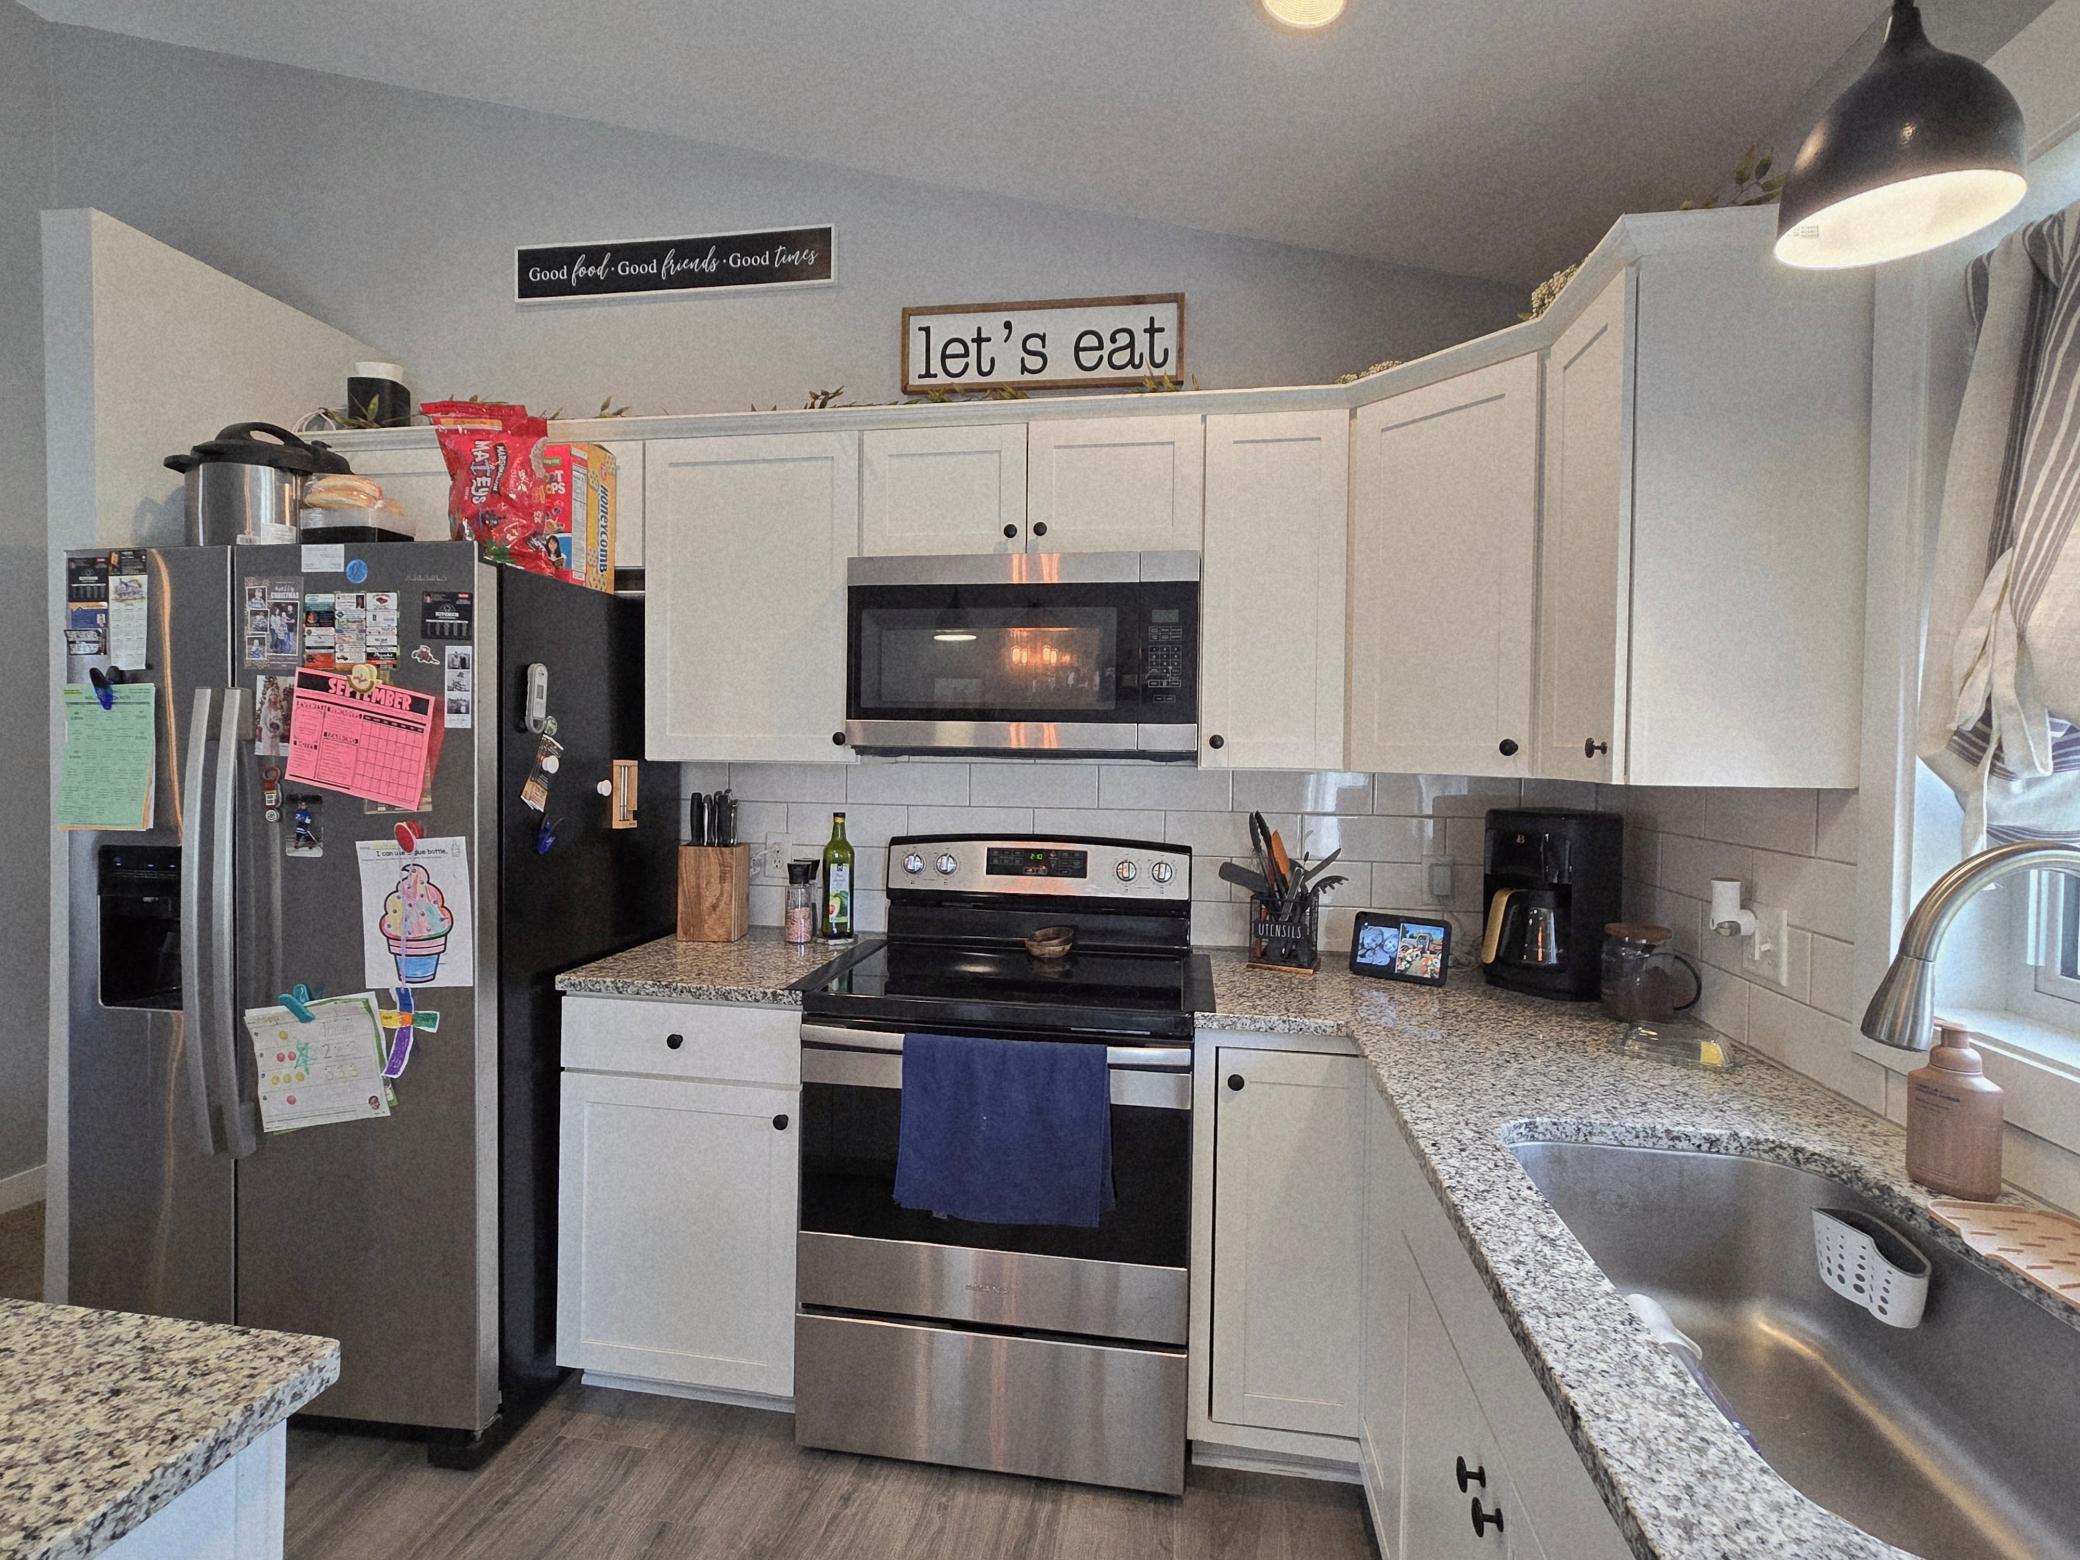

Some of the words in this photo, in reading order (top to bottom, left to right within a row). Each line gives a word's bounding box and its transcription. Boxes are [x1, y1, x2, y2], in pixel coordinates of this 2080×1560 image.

[528, 265, 567, 282] Good
[571, 252, 611, 287] food
[617, 259, 657, 276] Good
[661, 245, 720, 280] friends
[728, 251, 770, 268] Good
[774, 245, 819, 268] times
[917, 319, 1049, 379] let's
[1073, 316, 1170, 372] eat
[1258, 923, 1301, 939] UTENSILS
